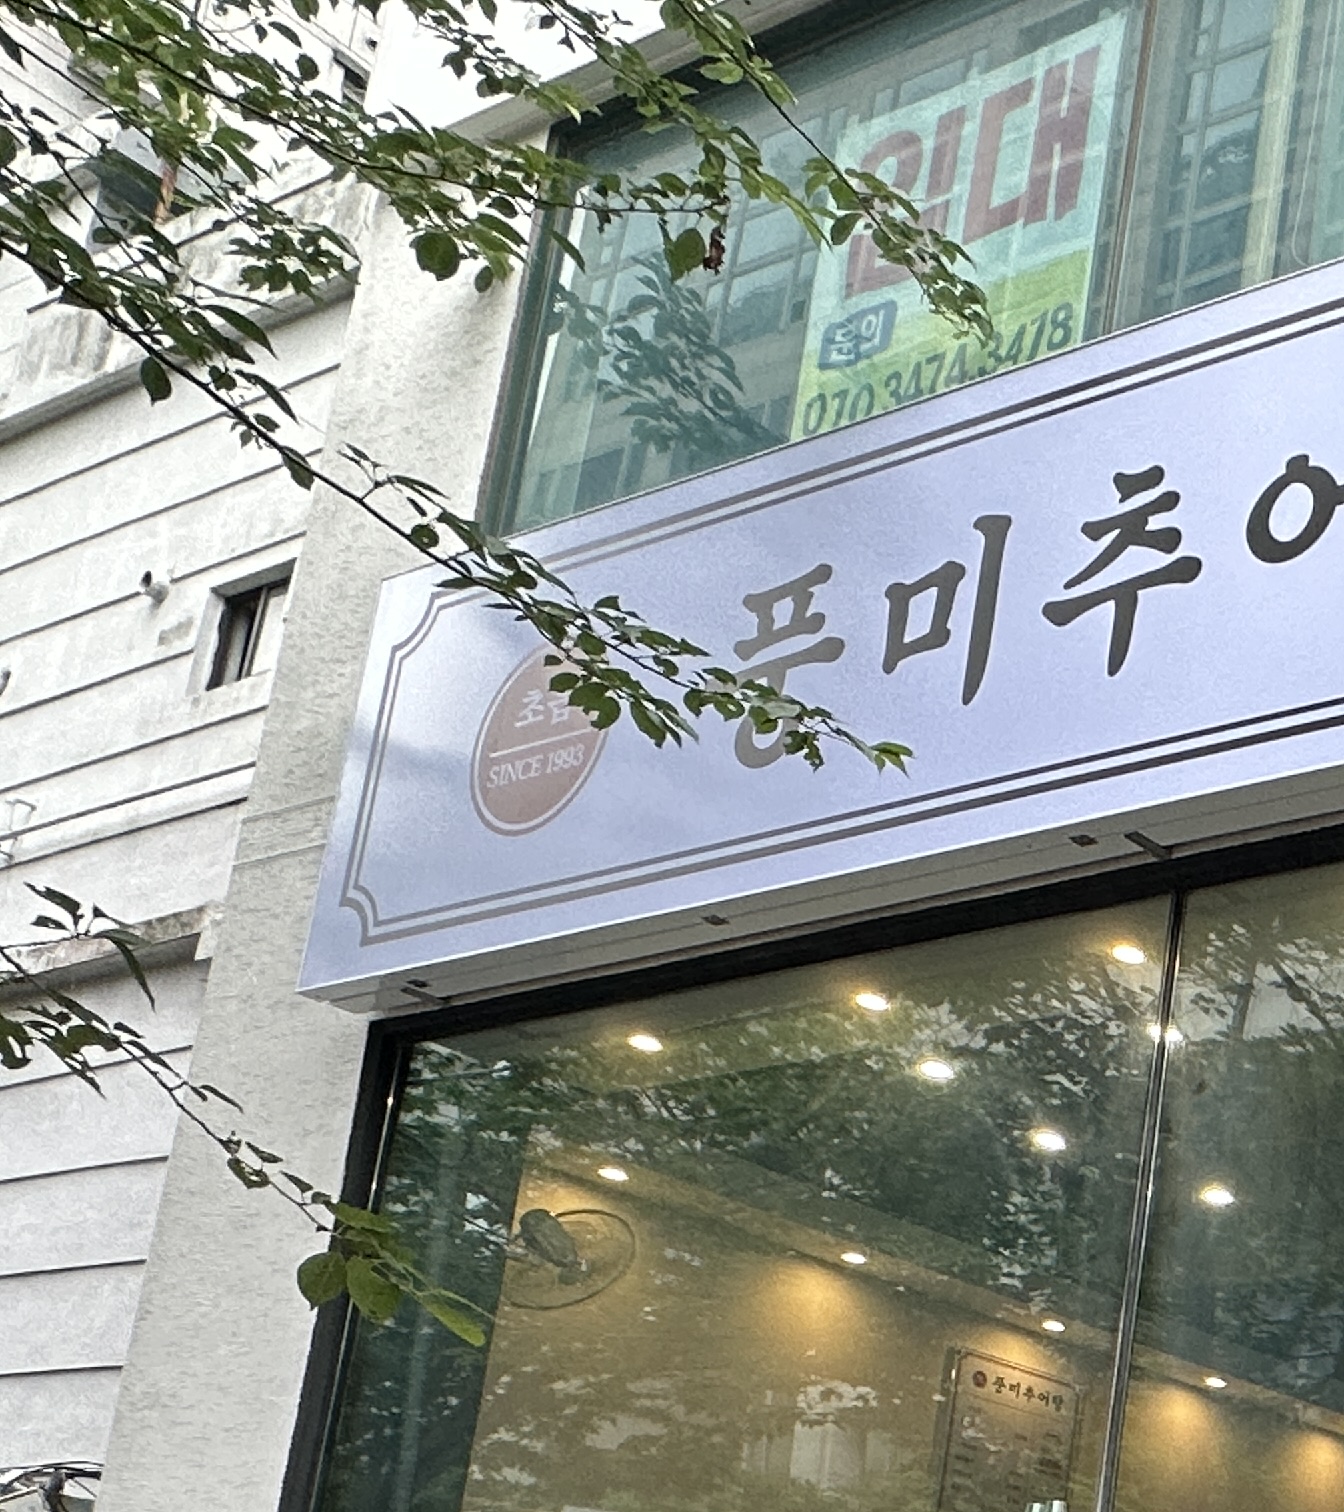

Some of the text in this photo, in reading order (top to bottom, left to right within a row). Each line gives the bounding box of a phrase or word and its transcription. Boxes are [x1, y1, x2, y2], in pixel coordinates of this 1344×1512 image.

[845, 44, 1102, 300] 임대
[829, 309, 885, 363] 문의
[487, 743, 585, 788] SINCE 1993
